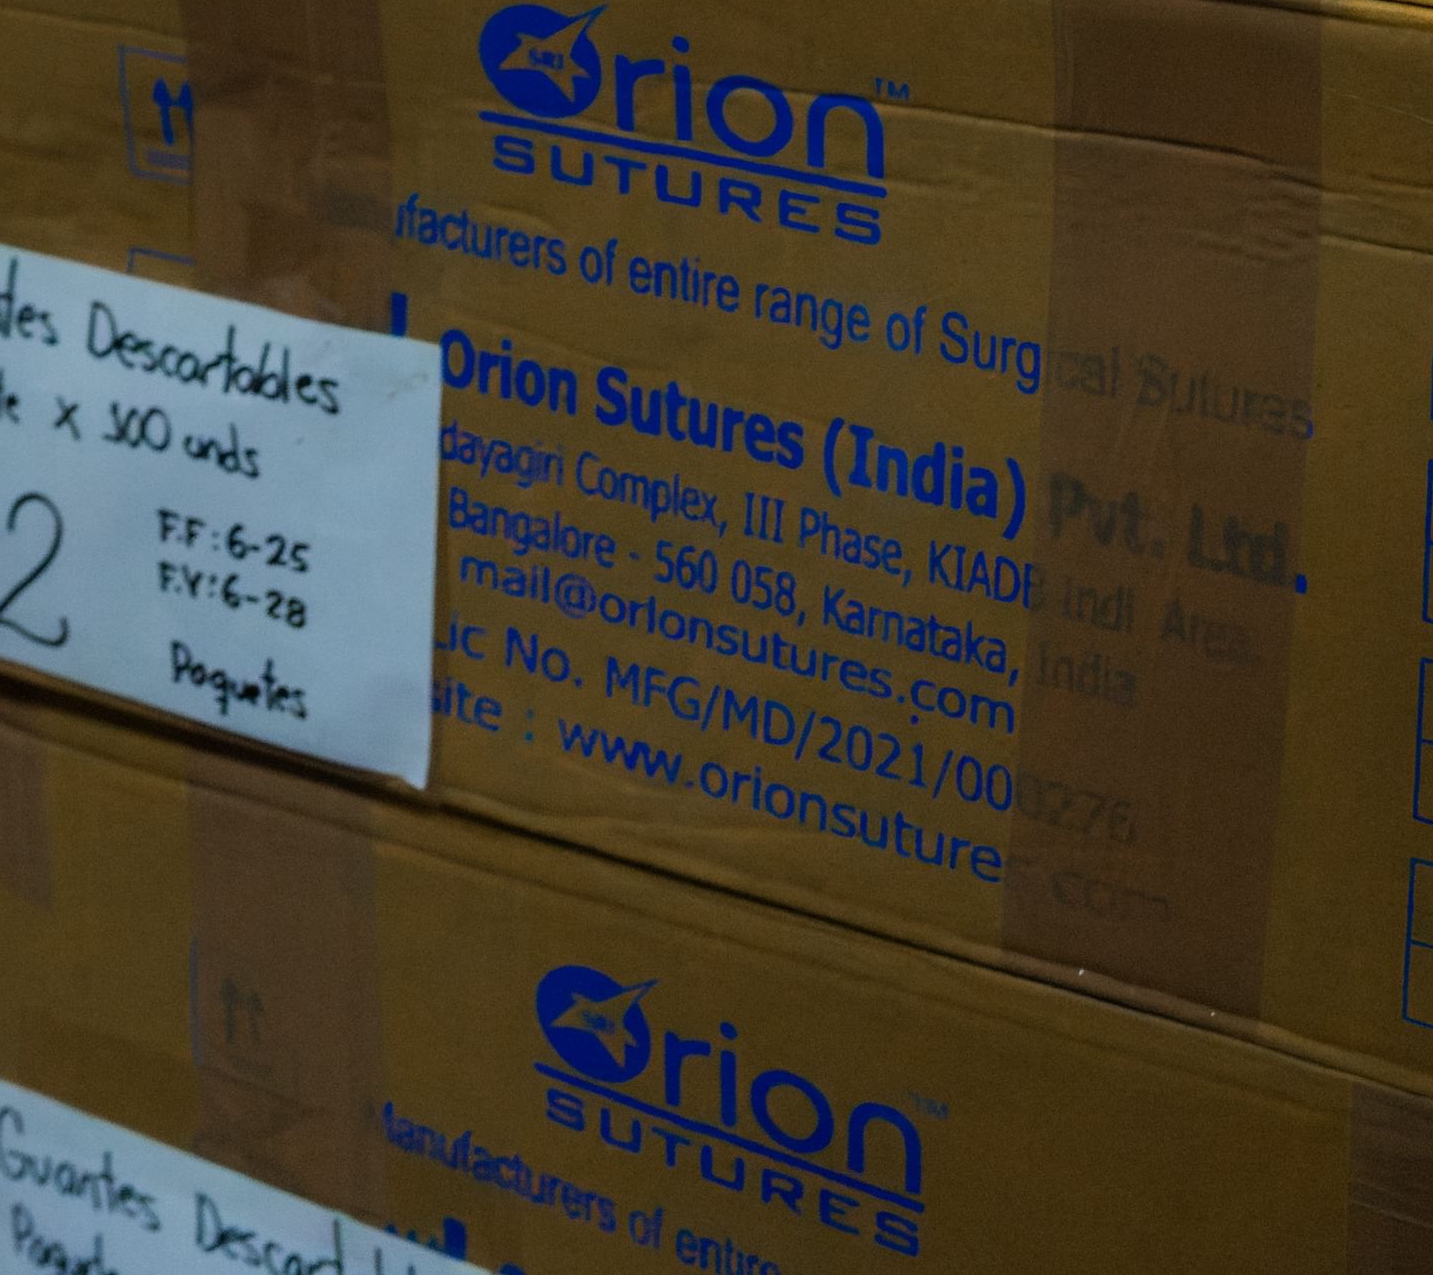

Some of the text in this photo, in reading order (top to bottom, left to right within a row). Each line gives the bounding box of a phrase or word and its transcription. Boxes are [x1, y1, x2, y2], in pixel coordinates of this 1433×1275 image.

[478, 3, 886, 180] Orion
[492, 134, 883, 246] SUTURES
[579, 238, 618, 286] of
[629, 257, 741, 313] entire
[754, 281, 871, 349] range
[886, 305, 928, 355] of
[439, 418, 565, 489] dayagiri
[574, 450, 728, 539] Complex,
[743, 491, 785, 544] III
[799, 506, 915, 587] Phase,
[440, 328, 578, 416] Orion
[595, 363, 805, 470] Sutures
[823, 417, 1027, 541] (India)
[447, 486, 617, 569] Bangalore
[653, 539, 719, 596] 560
[730, 558, 807, 628] 058,
[821, 585, 1019, 686] Karnataka,
[505, 626, 583, 688] No.
[535, 964, 923, 1195] Orion
[545, 1087, 921, 1258] SUTURES
